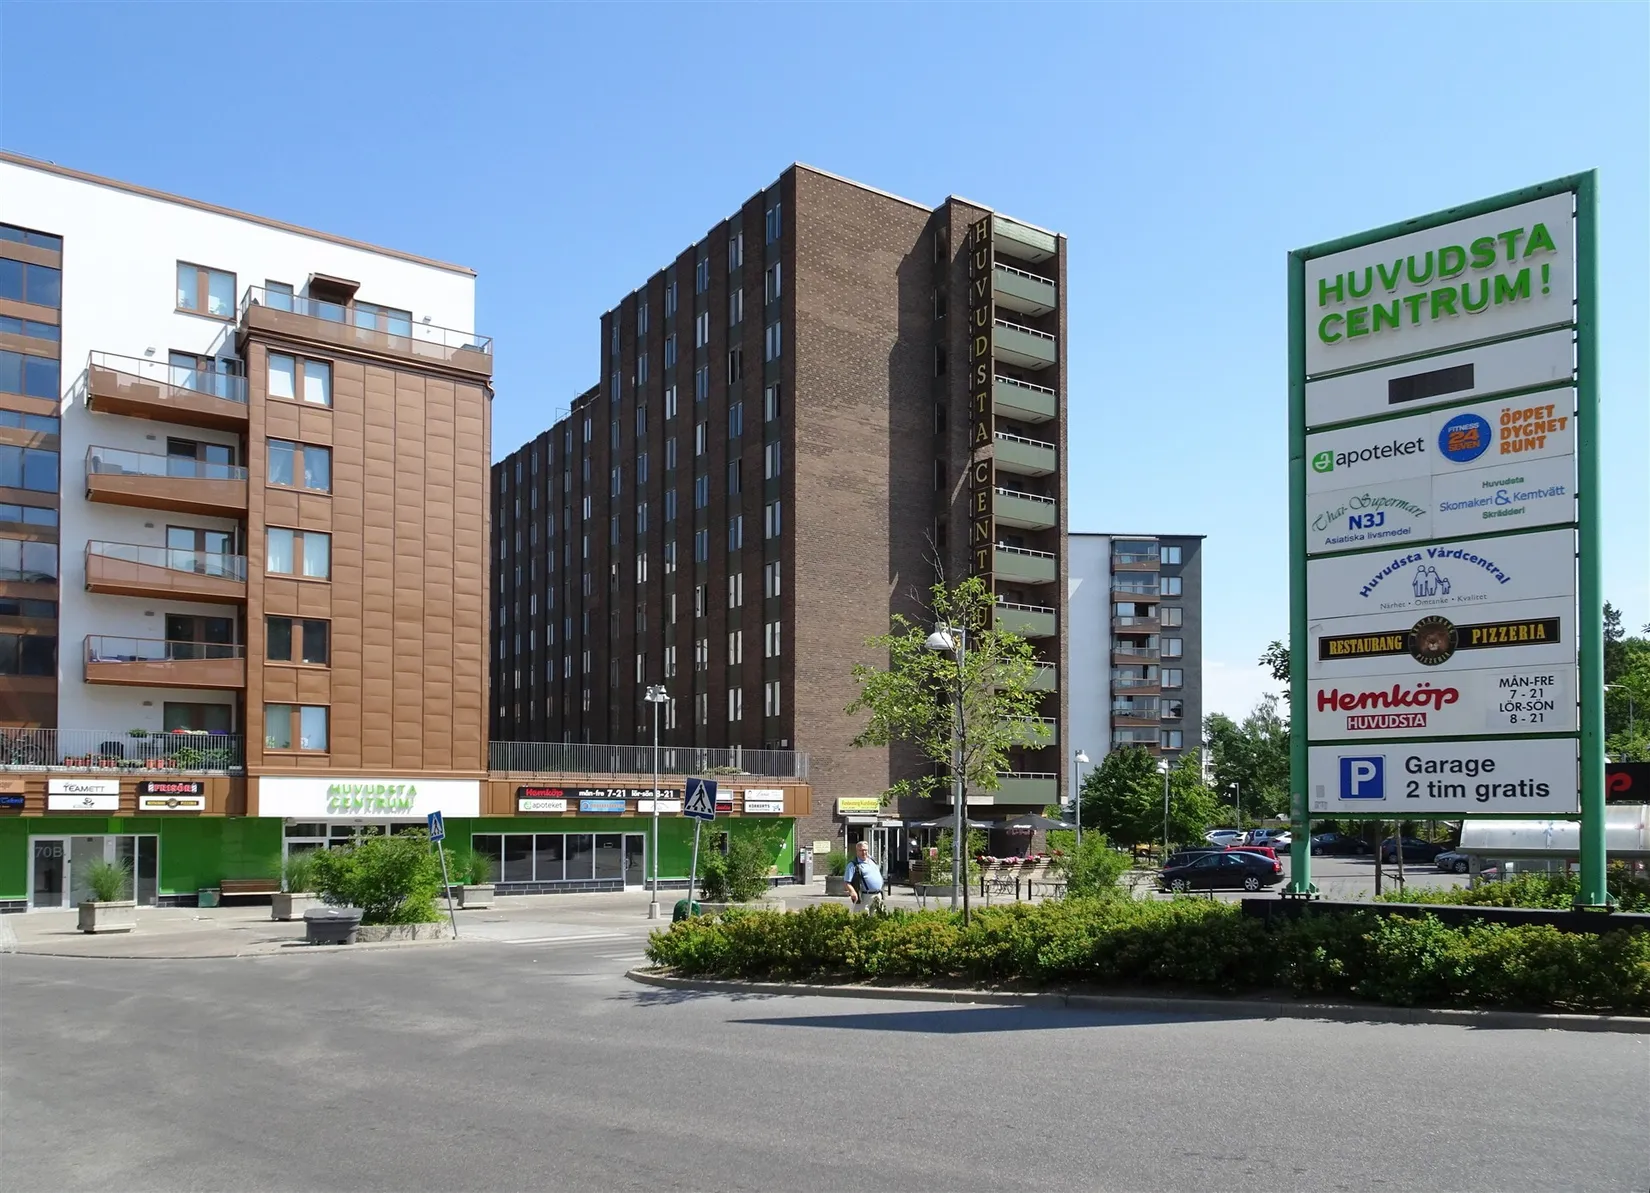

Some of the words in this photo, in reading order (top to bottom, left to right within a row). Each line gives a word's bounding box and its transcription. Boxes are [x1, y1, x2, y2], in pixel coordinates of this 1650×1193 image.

[1318, 222, 1558, 308] HUVUDSTA
[975, 219, 988, 443] HUVUDSTA
[1500, 404, 1555, 426] ÖPPET
[1448, 422, 1479, 432] FITNESS
[1449, 428, 1480, 443] 24
[1500, 417, 1568, 441] DYGNET
[1336, 437, 1425, 469] apoteket
[1448, 441, 1480, 451] SEVEN
[1500, 435, 1547, 455] RUNT
[1482, 476, 1524, 488] Huvudsta
[1349, 493, 1427, 518] Supermart
[1440, 496, 1493, 512] Skomakeri
[1494, 490, 1511, 505] &
[1513, 485, 1565, 501] Kemtvätt
[1349, 512, 1385, 530] N3J
[1482, 507, 1525, 519] Skrädderi
[1325, 533, 1365, 545] Asiatiska
[1367, 526, 1411, 540] livsmedel
[1359, 552, 1422, 598] Huvudsta
[1427, 548, 1511, 585] Vårdcentral
[1415, 597, 1448, 607] Omtanke
[1457, 593, 1487, 602] Kvalitet
[1472, 623, 1546, 645] PIZZERIA
[1329, 635, 1403, 655] RESTAURANG
[1499, 675, 1555, 688] MÅN-FRE
[1317, 682, 1459, 712] Hemköp
[1510, 690, 1516, 699] 7
[1530, 689, 1544, 698] 21
[1499, 699, 1554, 712] LÖR-SÖN
[1348, 713, 1426, 730] HUVUDSTA
[1510, 714, 1517, 724] 8
[1530, 713, 1544, 723] 21
[1405, 755, 1495, 777] Garage
[1351, 761, 1376, 795] P
[330, 784, 417, 795] HUVUDSTA
[525, 788, 564, 798] Hemköp
[1406, 781, 1420, 798] 2
[1427, 780, 1466, 798] tim
[1475, 779, 1550, 803] gratis
[35, 847, 64, 858] 70B
